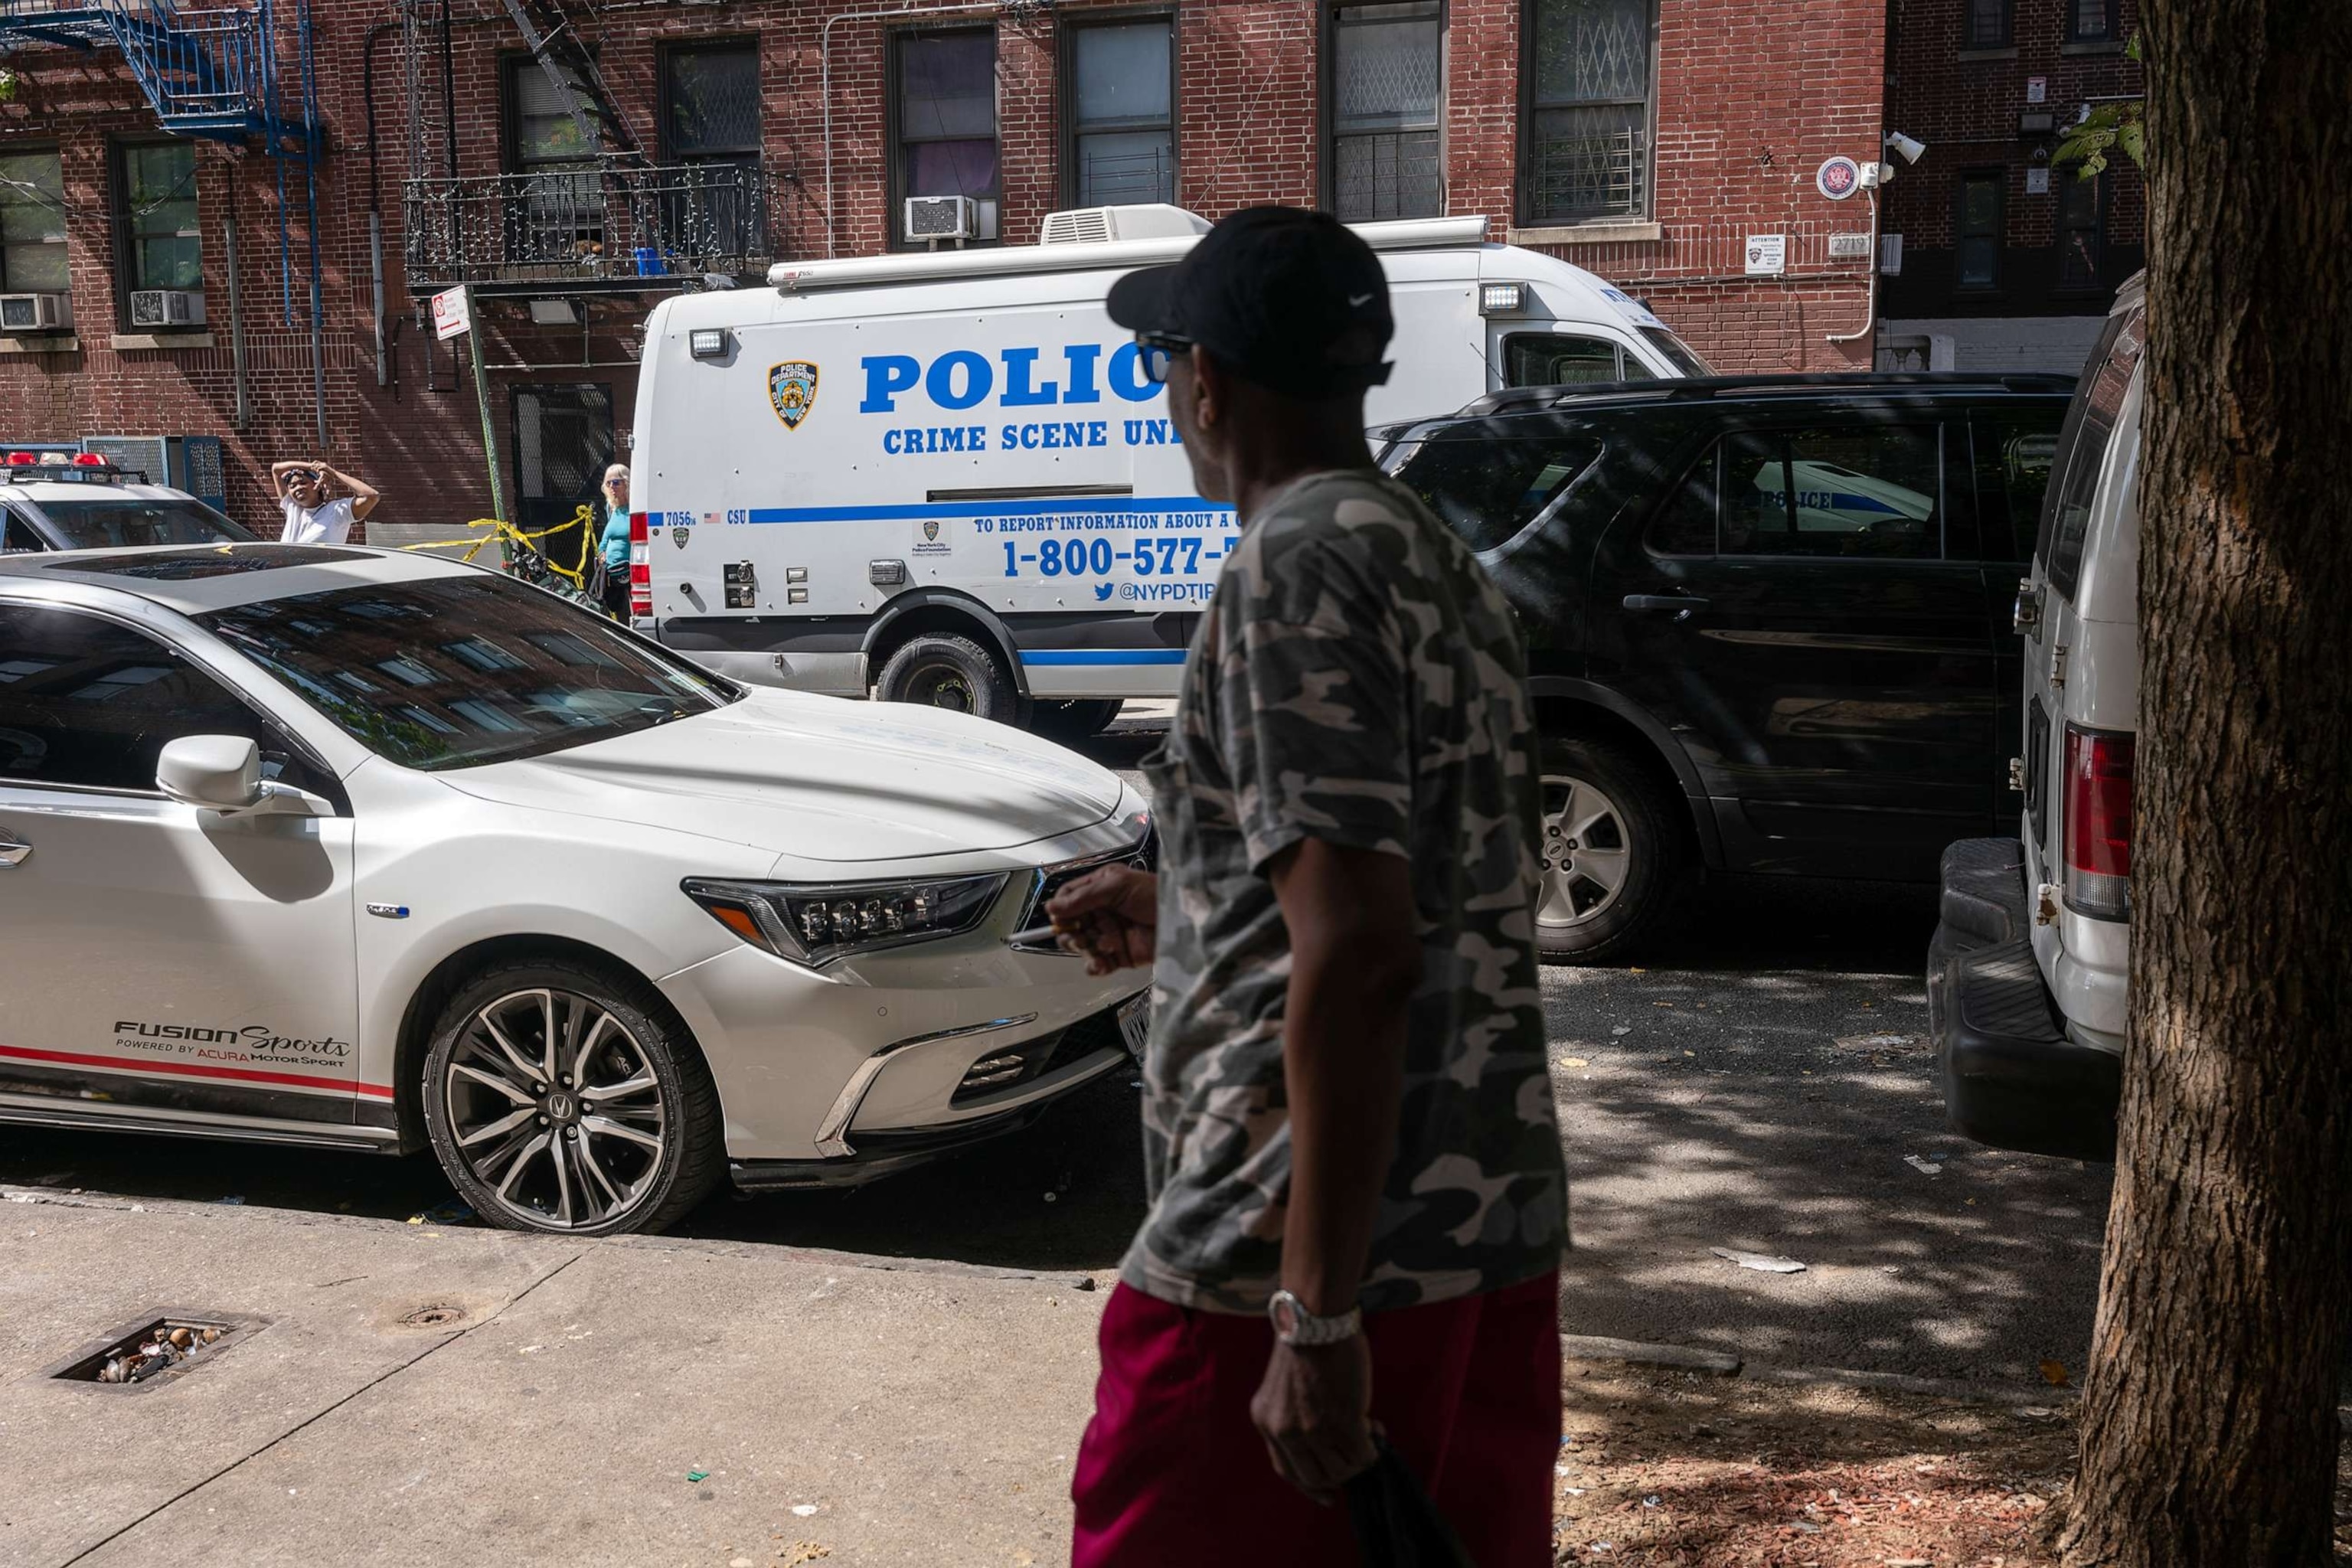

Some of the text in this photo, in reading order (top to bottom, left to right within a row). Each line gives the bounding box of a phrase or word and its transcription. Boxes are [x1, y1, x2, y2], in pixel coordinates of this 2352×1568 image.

[1834, 237, 1865, 251] 2719
[780, 363, 808, 373] POLICE
[859, 341, 1170, 413] POLIC
[771, 371, 816, 385] DEPARTMENT
[772, 391, 788, 419] CITY OF
[795, 385, 815, 421] NEW YORK
[883, 419, 1184, 455] CRIME SCENE UNI
[1762, 491, 1831, 509] POICE
[666, 511, 691, 526] 7056
[727, 509, 746, 524] CSU
[976, 518, 994, 533] TO
[999, 516, 1054, 532] REPORT
[1060, 514, 1159, 531] INFORMATION
[1165, 514, 1213, 528] ABOUT
[1220, 513, 1229, 528] A
[1119, 583, 1216, 600] @NYPDTIP
[114, 1021, 351, 1057] FUSION Sports
[116, 1039, 173, 1052] POWERED
[178, 1045, 194, 1054] BY
[197, 1048, 250, 1062] ACURA
